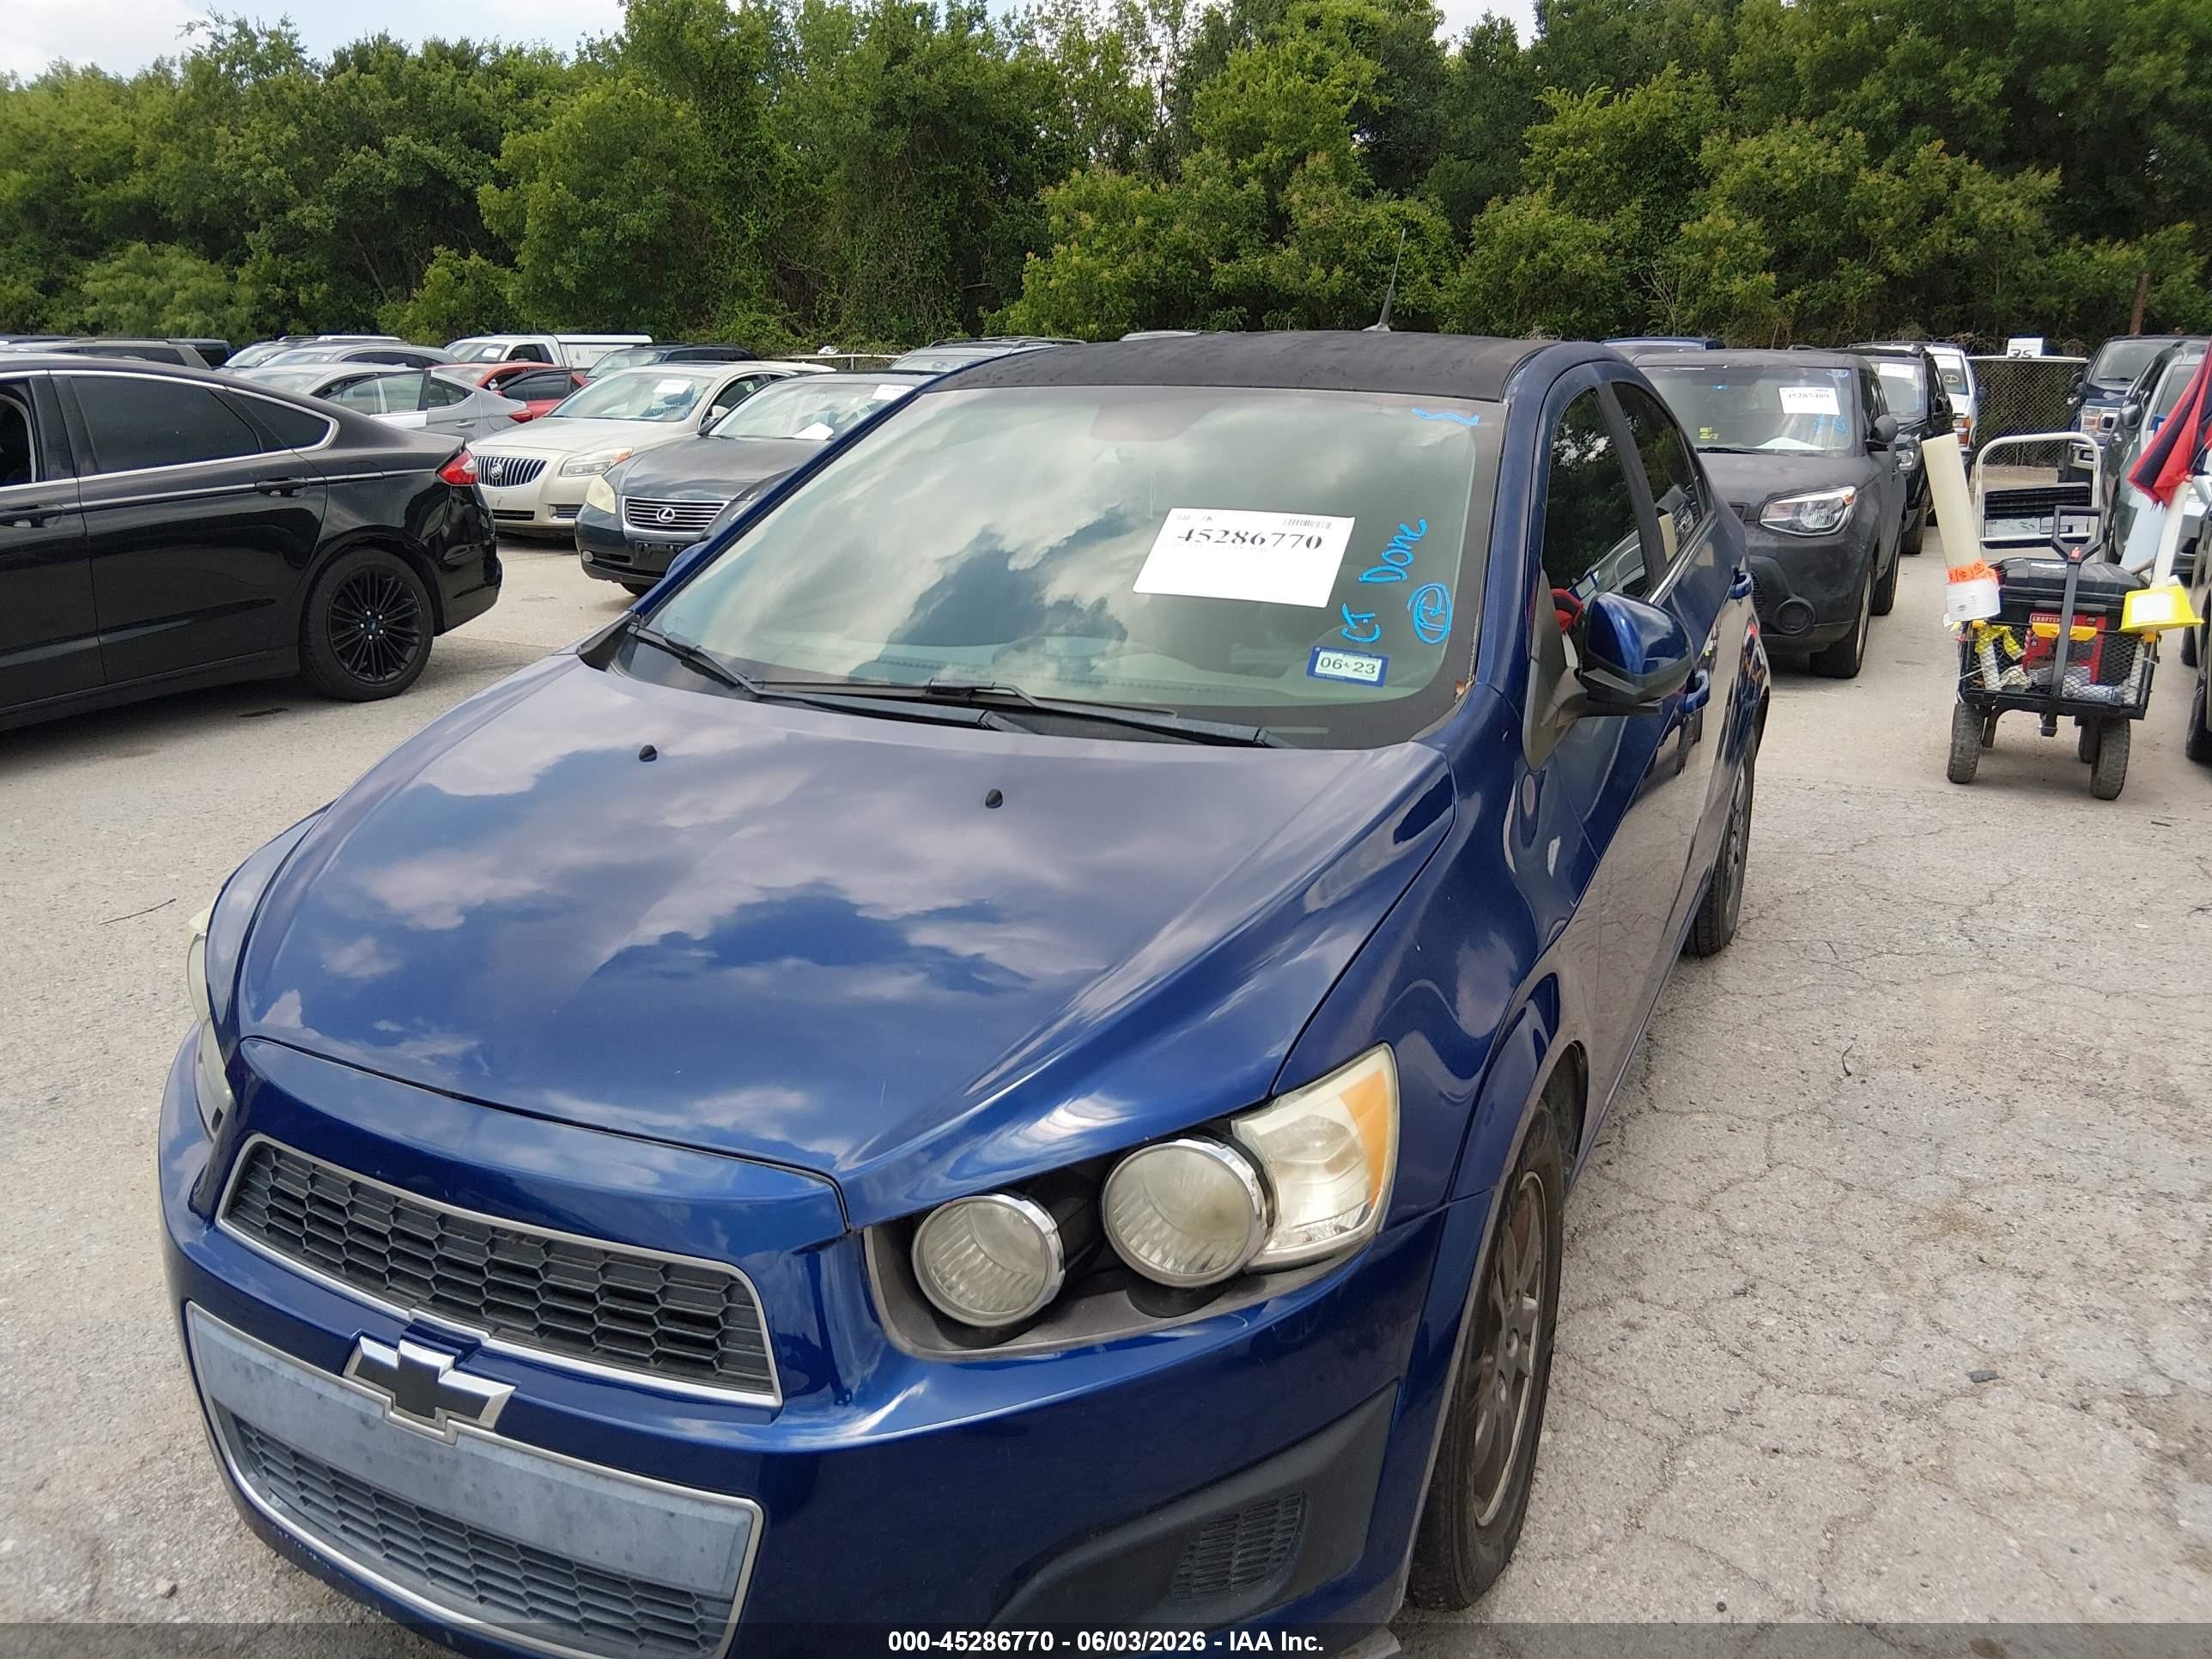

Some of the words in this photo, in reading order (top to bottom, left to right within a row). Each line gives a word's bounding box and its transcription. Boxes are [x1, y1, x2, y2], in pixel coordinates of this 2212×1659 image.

[1177, 528, 1323, 550] 45286770
[1358, 518, 1428, 583] Done
[1320, 657, 1344, 670] 06
[1352, 661, 1376, 675] 23
